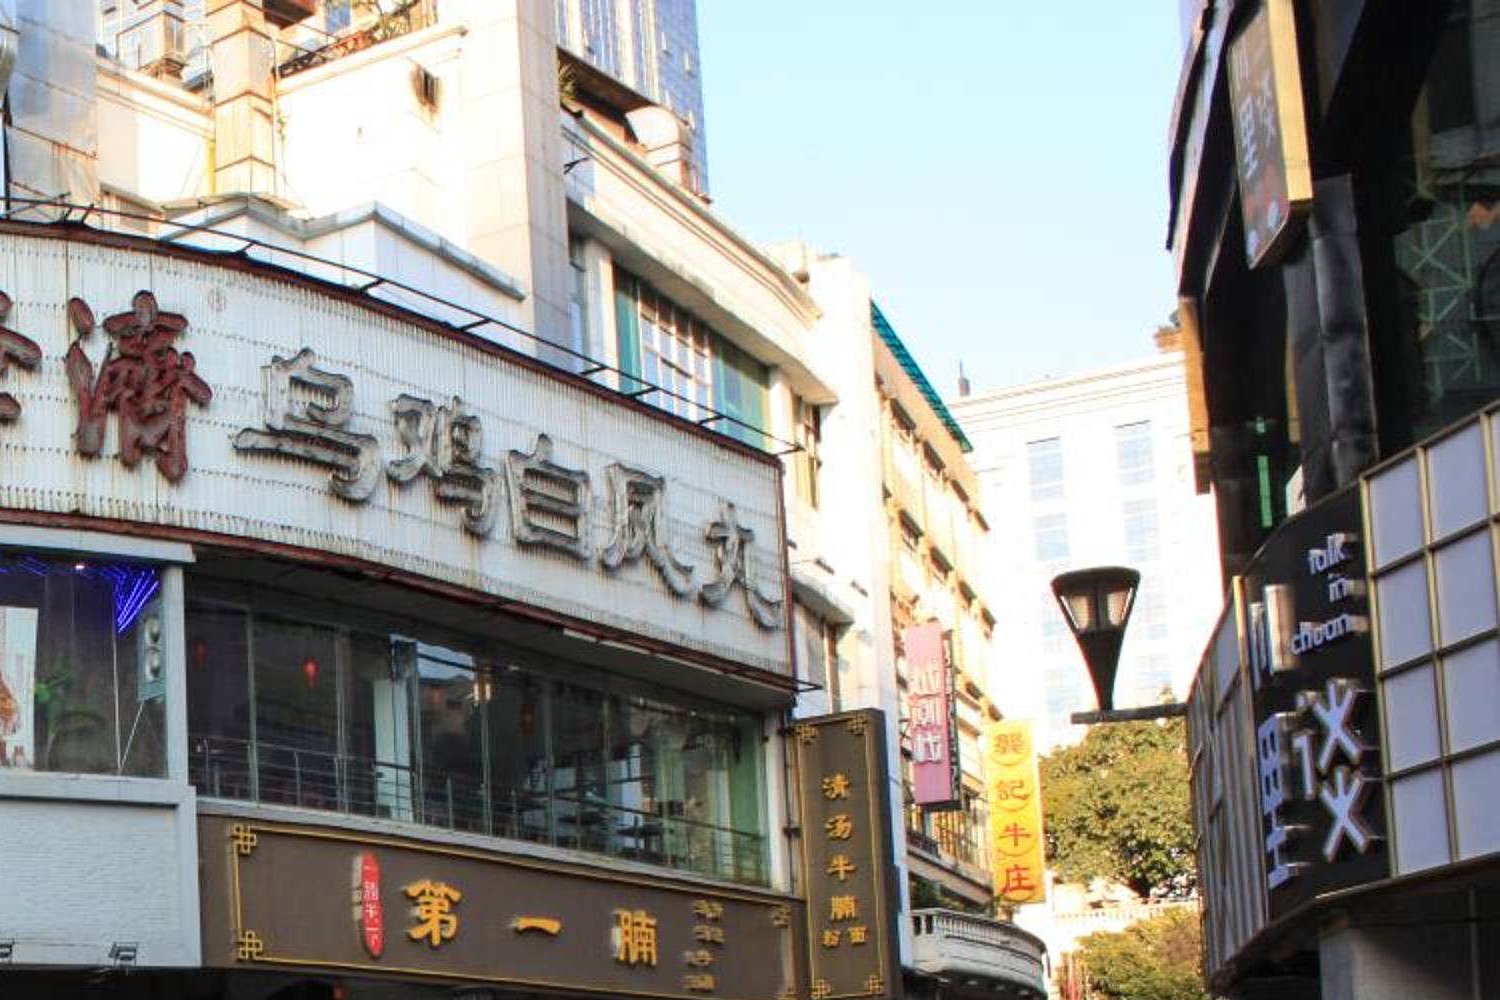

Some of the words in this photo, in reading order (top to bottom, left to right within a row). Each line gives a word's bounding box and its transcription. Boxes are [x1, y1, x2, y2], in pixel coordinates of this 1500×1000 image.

[232, 347, 784, 630] 乌鸡白凤丸
[1307, 533, 1349, 575] talk
[1328, 573, 1352, 603] in
[1290, 613, 1353, 655] chuan
[402, 880, 658, 966] 第一腩
